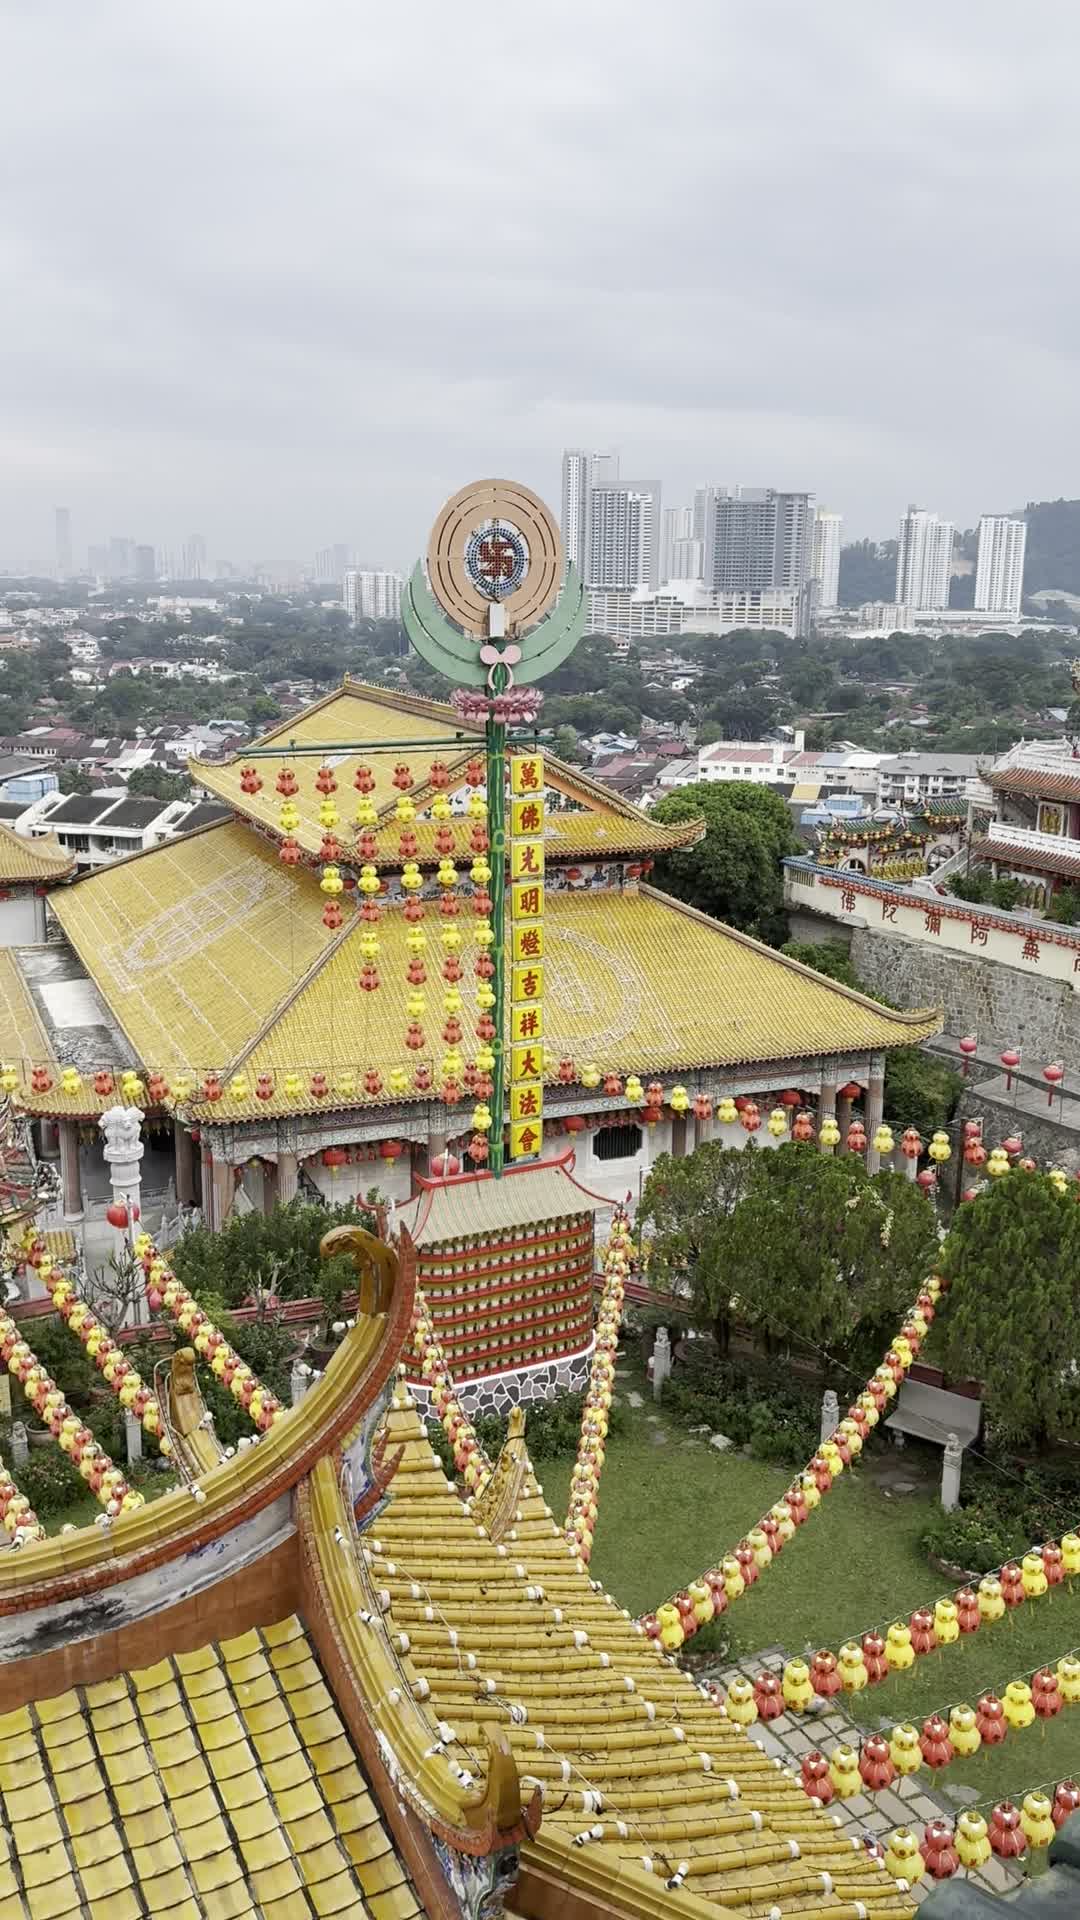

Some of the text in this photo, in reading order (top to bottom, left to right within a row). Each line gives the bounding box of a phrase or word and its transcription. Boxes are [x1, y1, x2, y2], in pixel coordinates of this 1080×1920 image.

[518, 761, 541, 1152] 萬佛光明燈吉祥大法會
